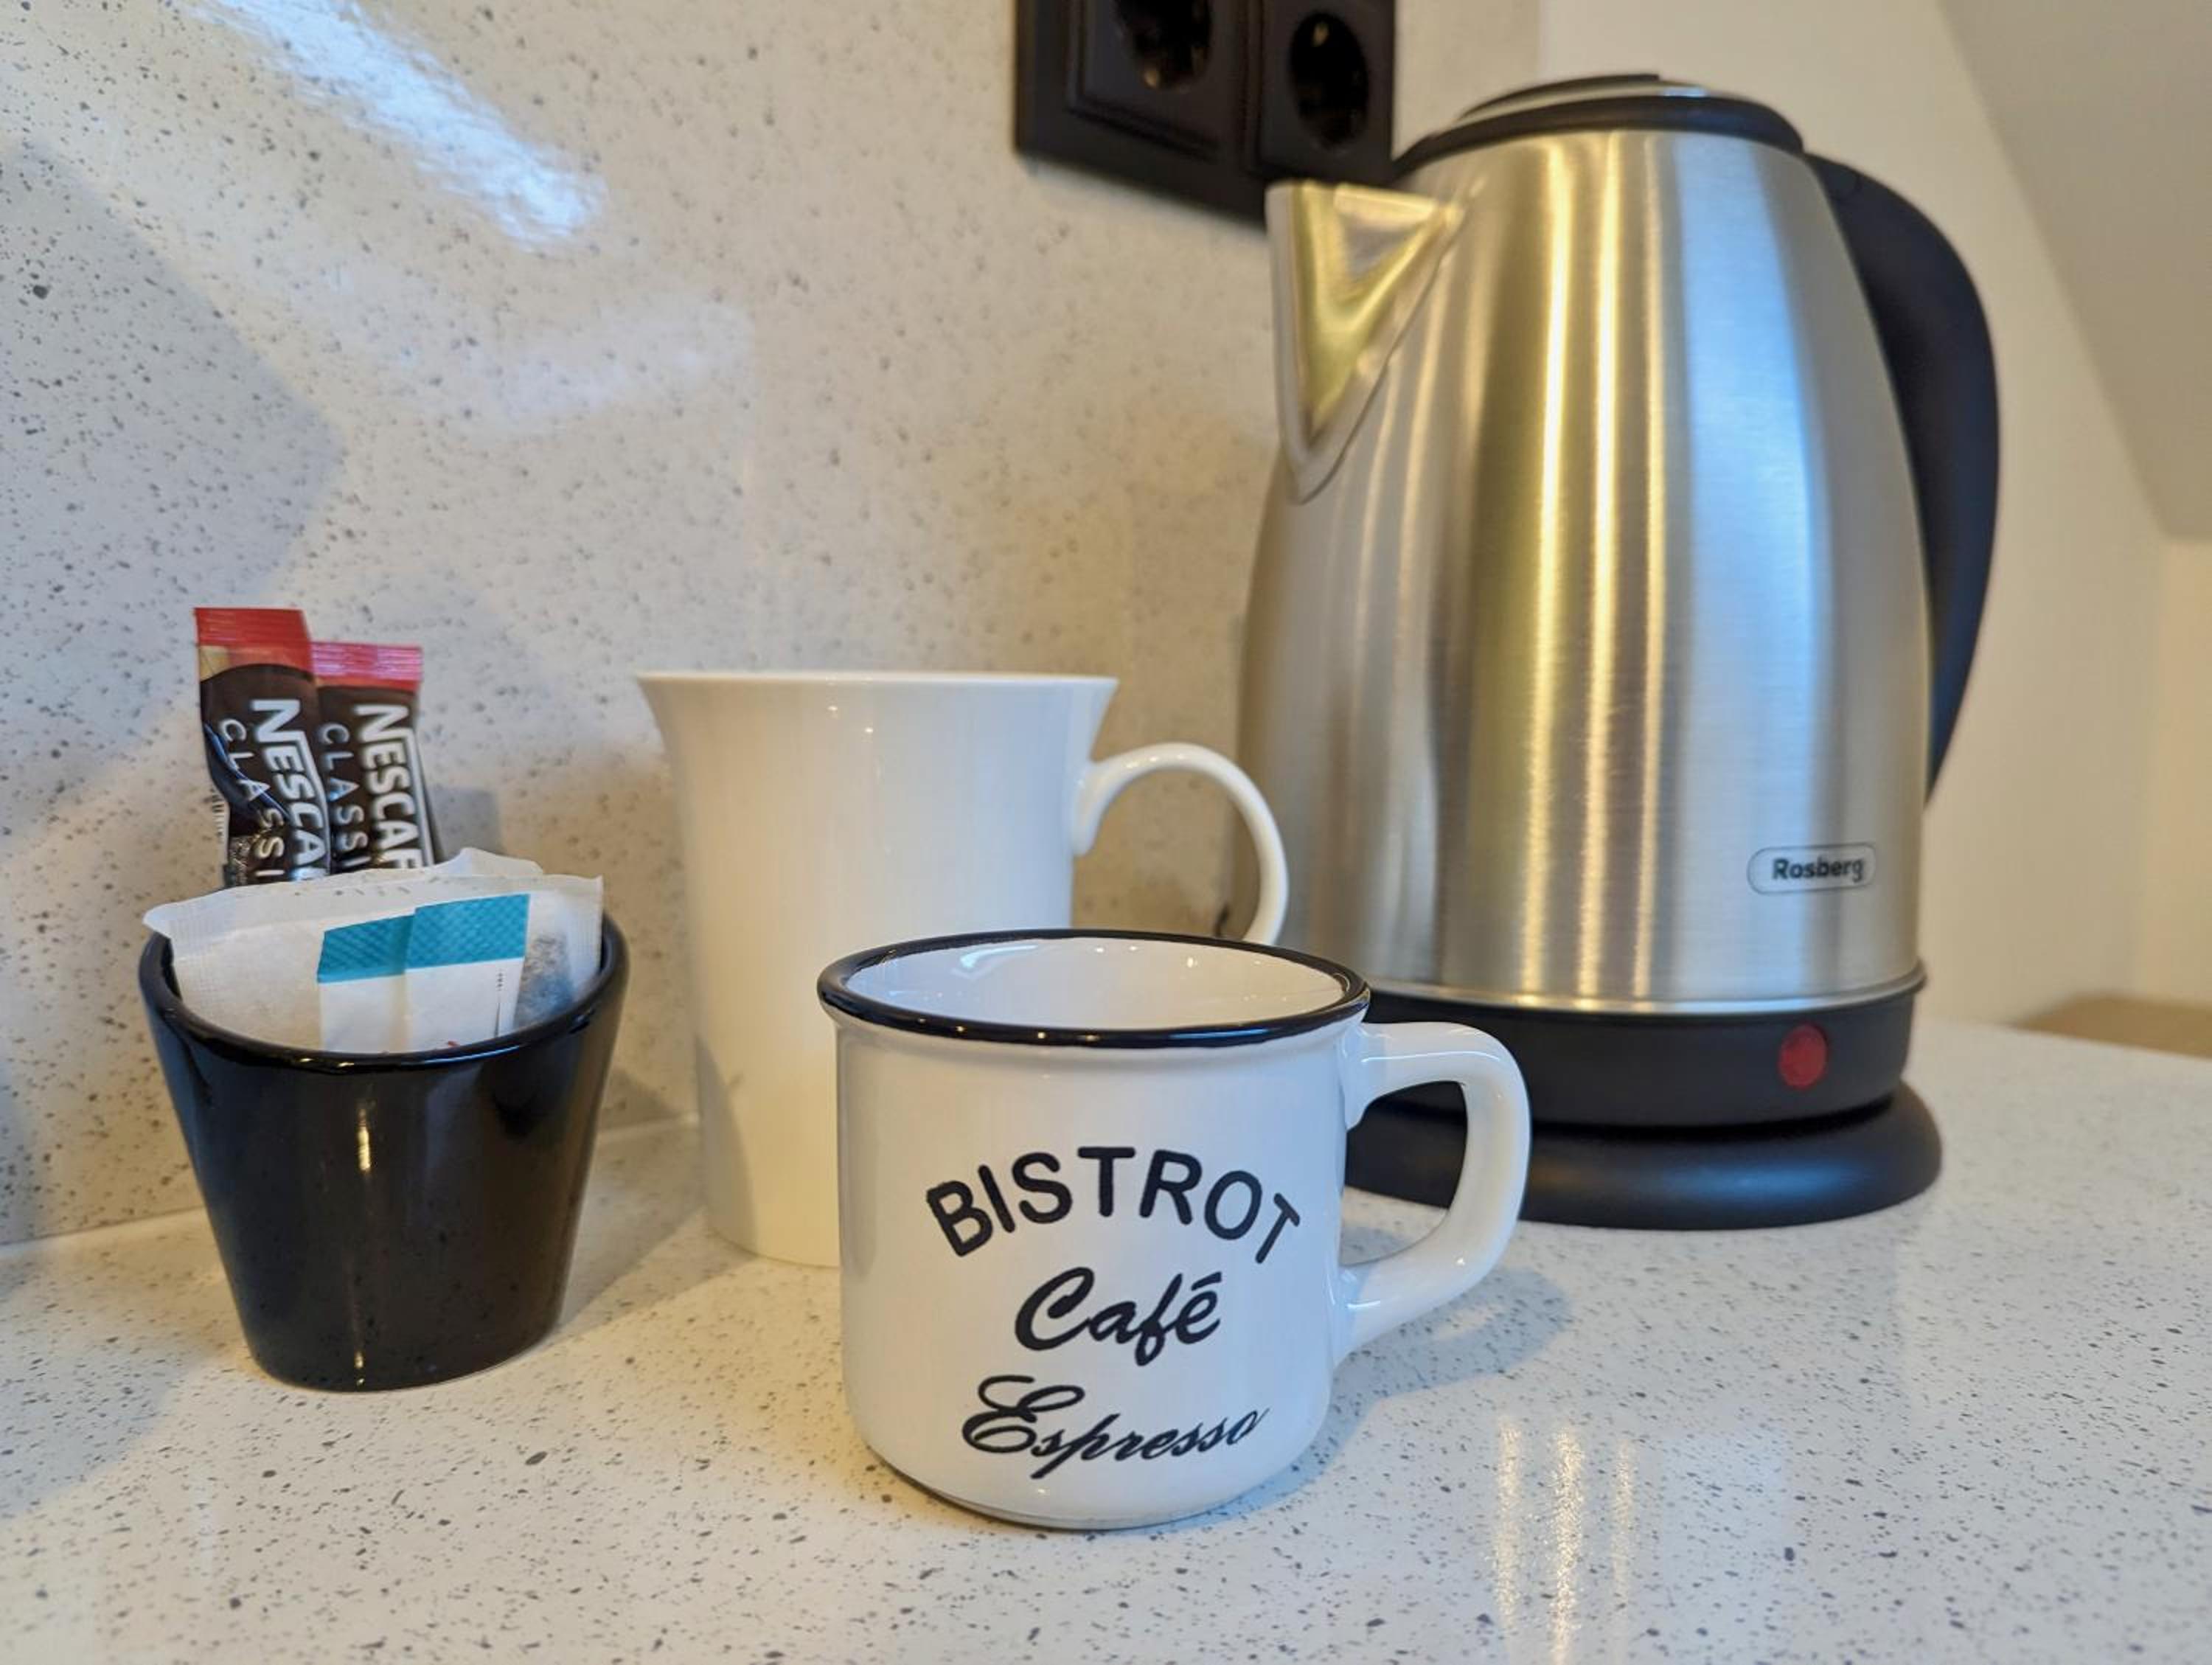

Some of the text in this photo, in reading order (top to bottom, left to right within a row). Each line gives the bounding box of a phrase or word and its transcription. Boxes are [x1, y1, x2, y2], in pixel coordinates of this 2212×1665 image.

[1771, 856, 1865, 883] Rosberg
[925, 1145, 1301, 1265] BISTROT
[1014, 1266, 1222, 1366] Café
[961, 1374, 1270, 1479] Espresso
